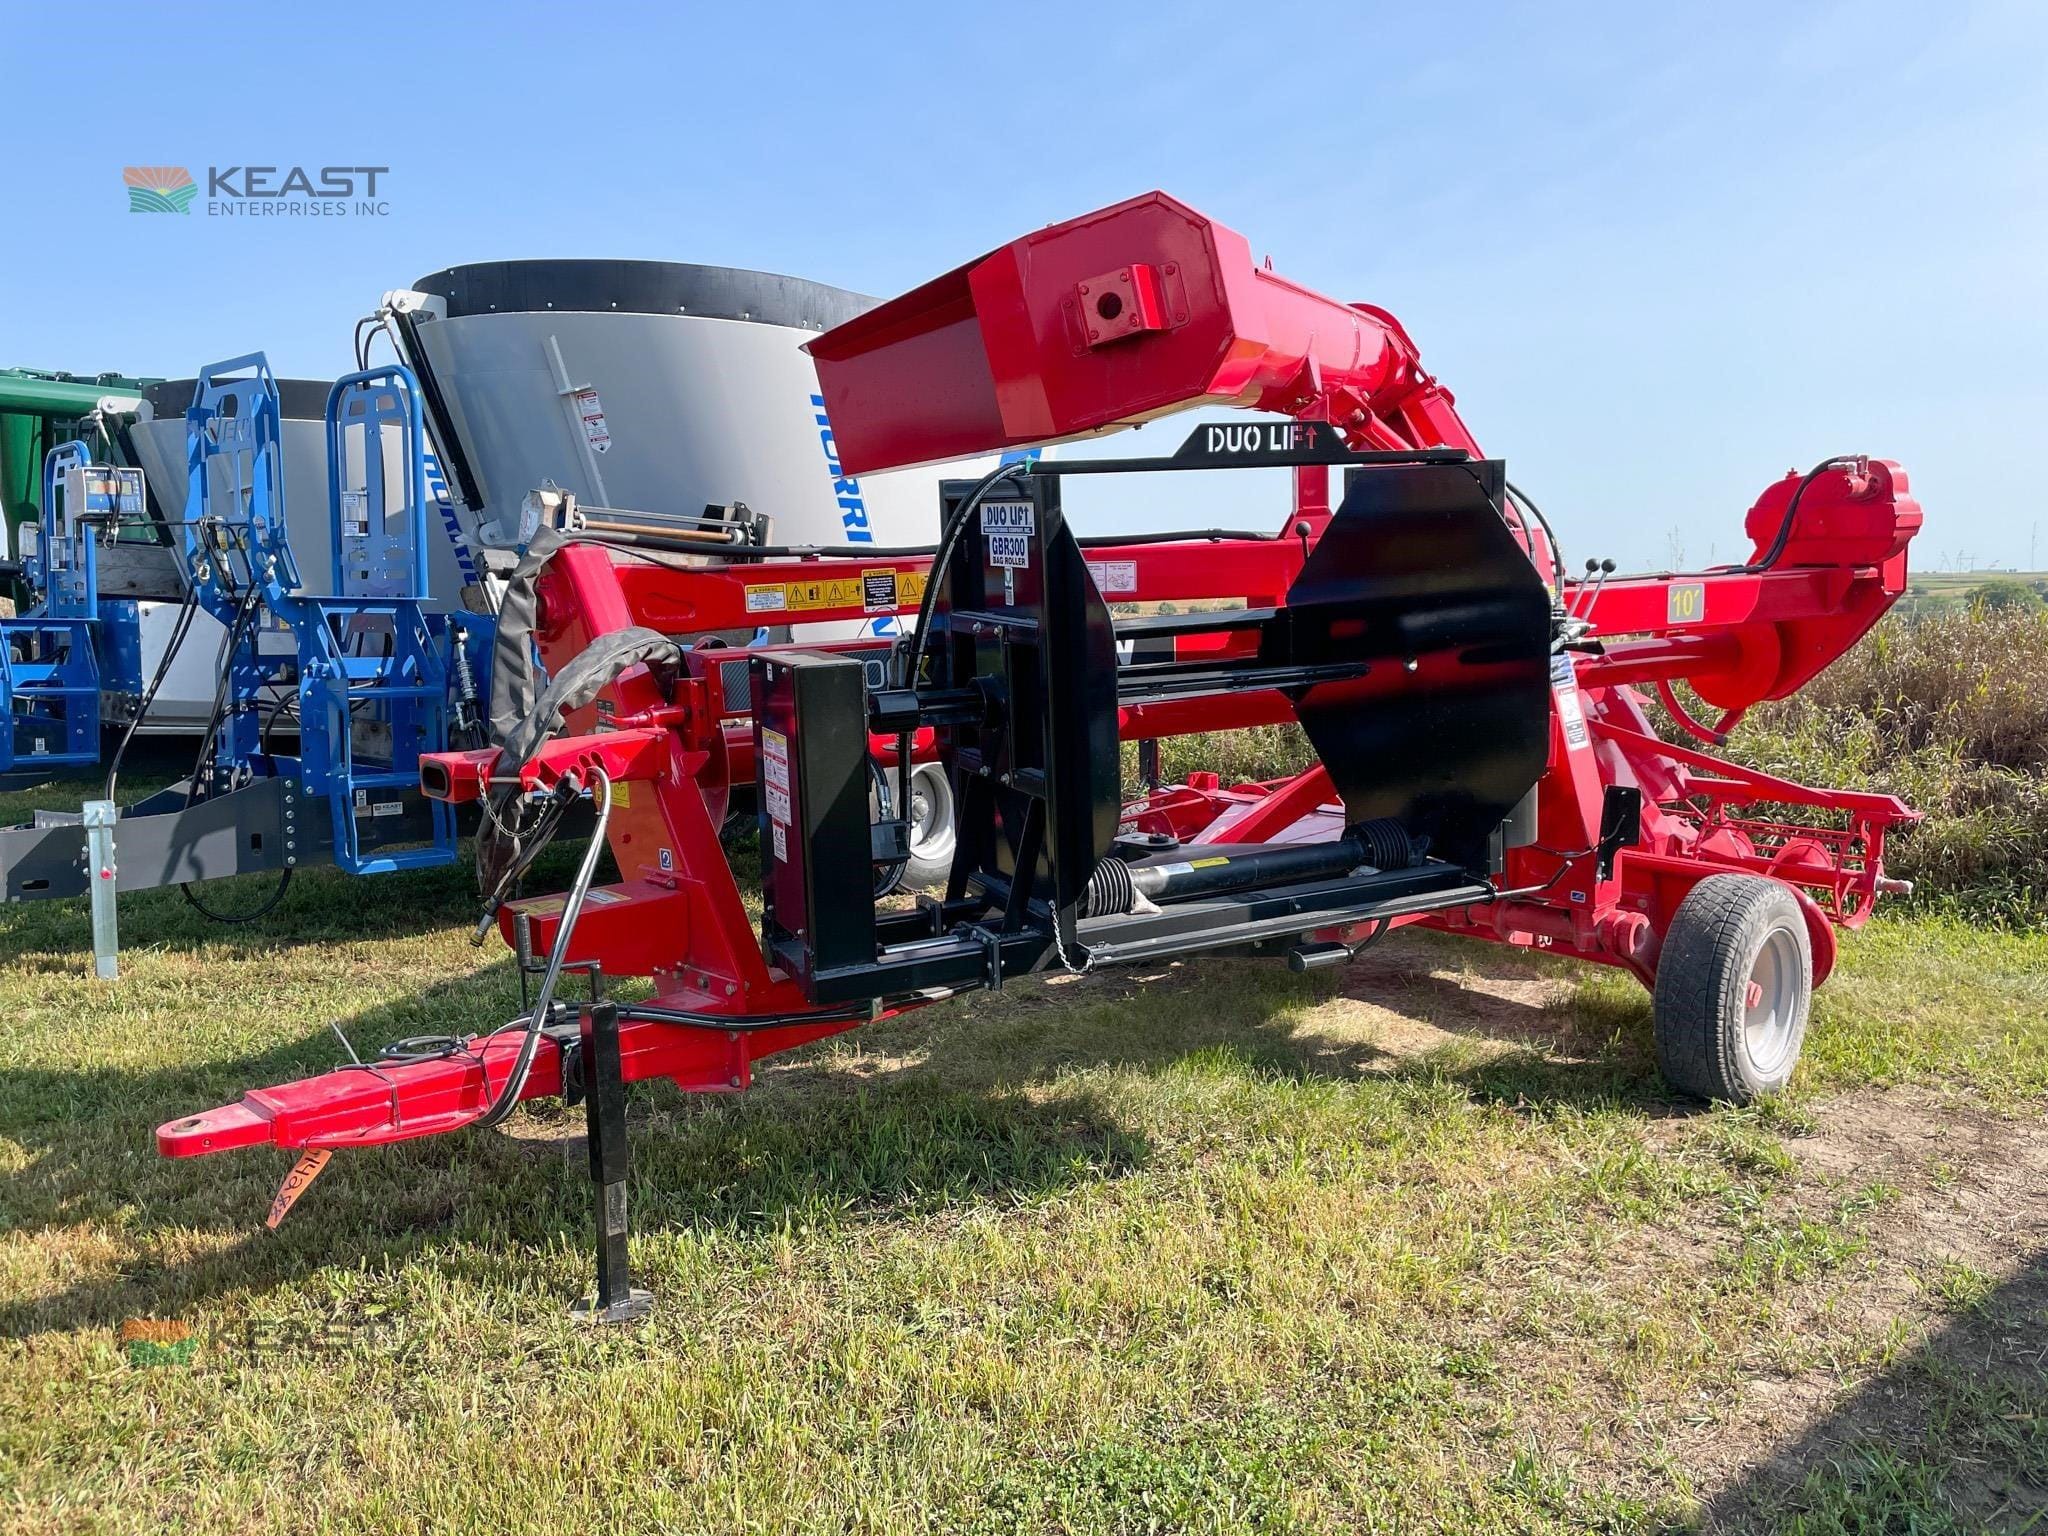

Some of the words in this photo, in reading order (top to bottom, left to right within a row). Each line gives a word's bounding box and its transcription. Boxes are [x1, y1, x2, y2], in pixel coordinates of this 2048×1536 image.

[1207, 425, 1262, 453] DUO
[986, 505, 1007, 526] DUO
[992, 536, 1025, 557] GBR300
[992, 556, 1004, 565] BAG
[1004, 556, 1026, 566] ROLLER
